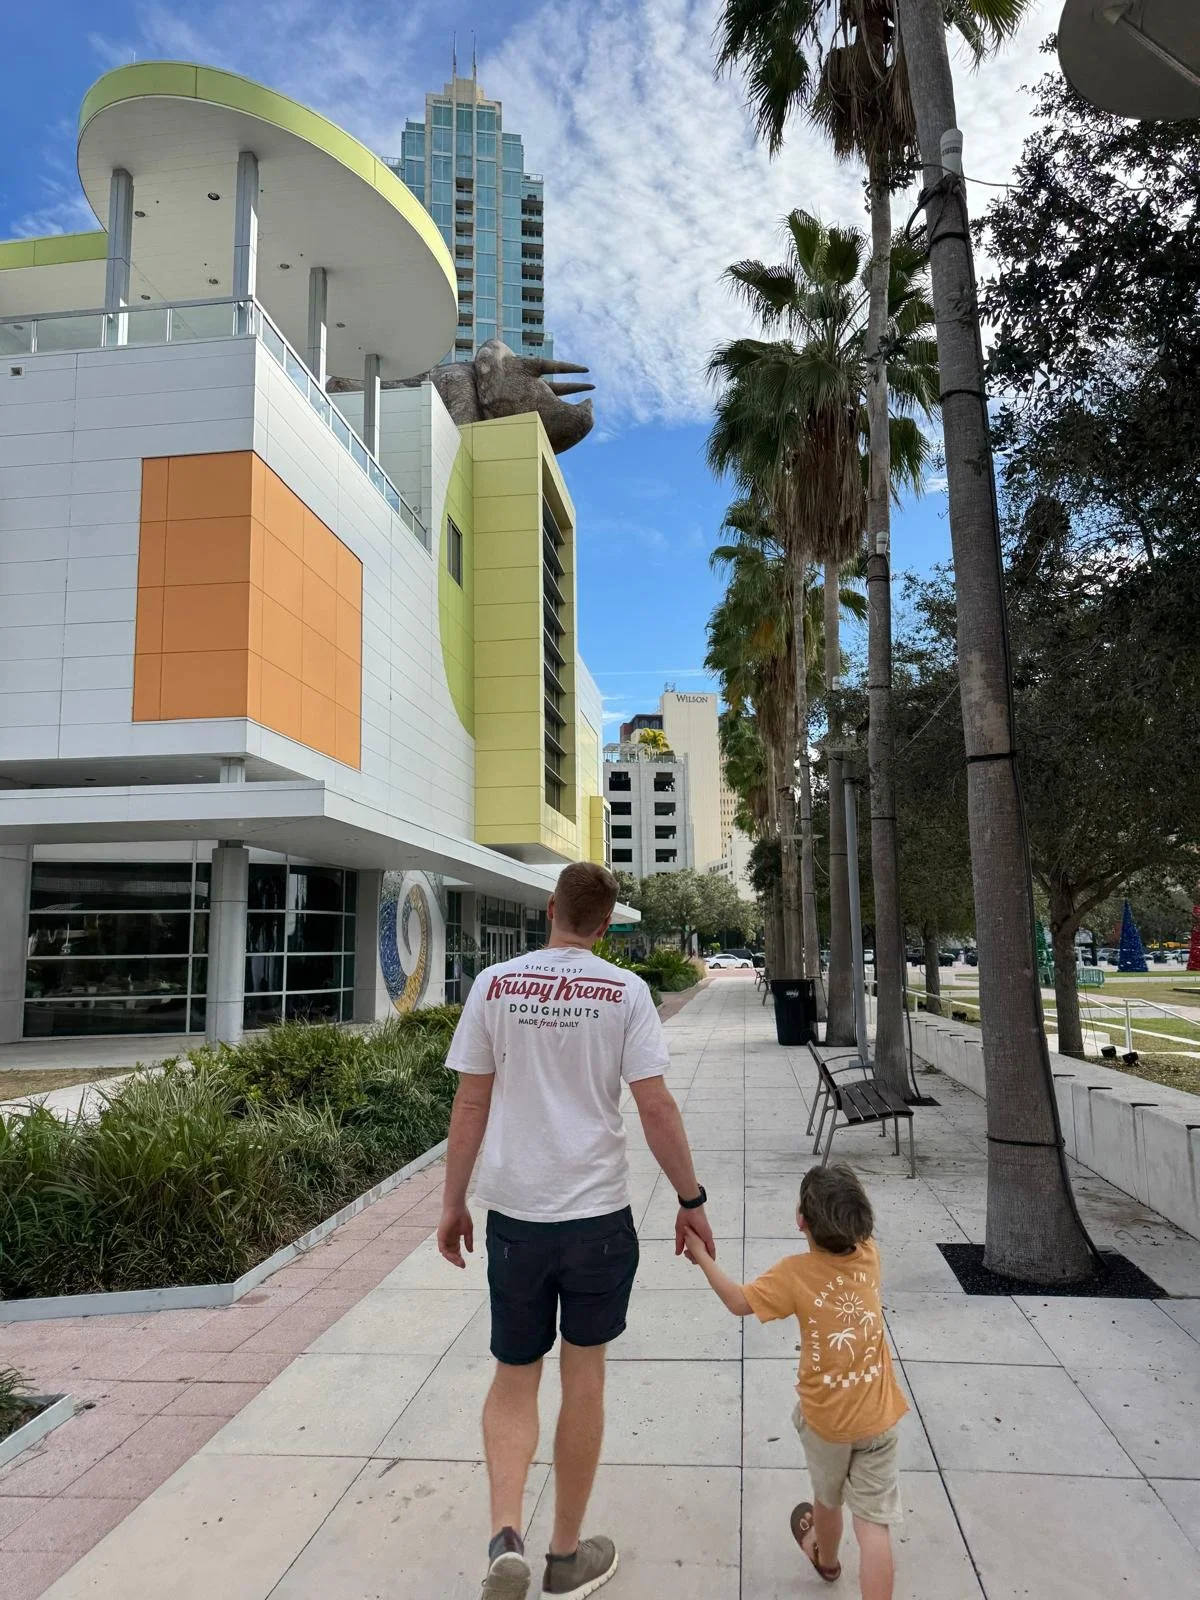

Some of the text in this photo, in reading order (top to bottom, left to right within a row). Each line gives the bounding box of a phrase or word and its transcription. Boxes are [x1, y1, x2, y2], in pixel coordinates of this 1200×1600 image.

[525, 964, 556, 972] SINCE
[486, 973, 626, 1003] Krispy Kreme
[509, 1003, 600, 1019] DOUGHNUTS
[518, 1018, 538, 1026] MADE
[538, 1018, 557, 1028] fresh
[808, 1271, 866, 1372] SUNNY DAYS IN
